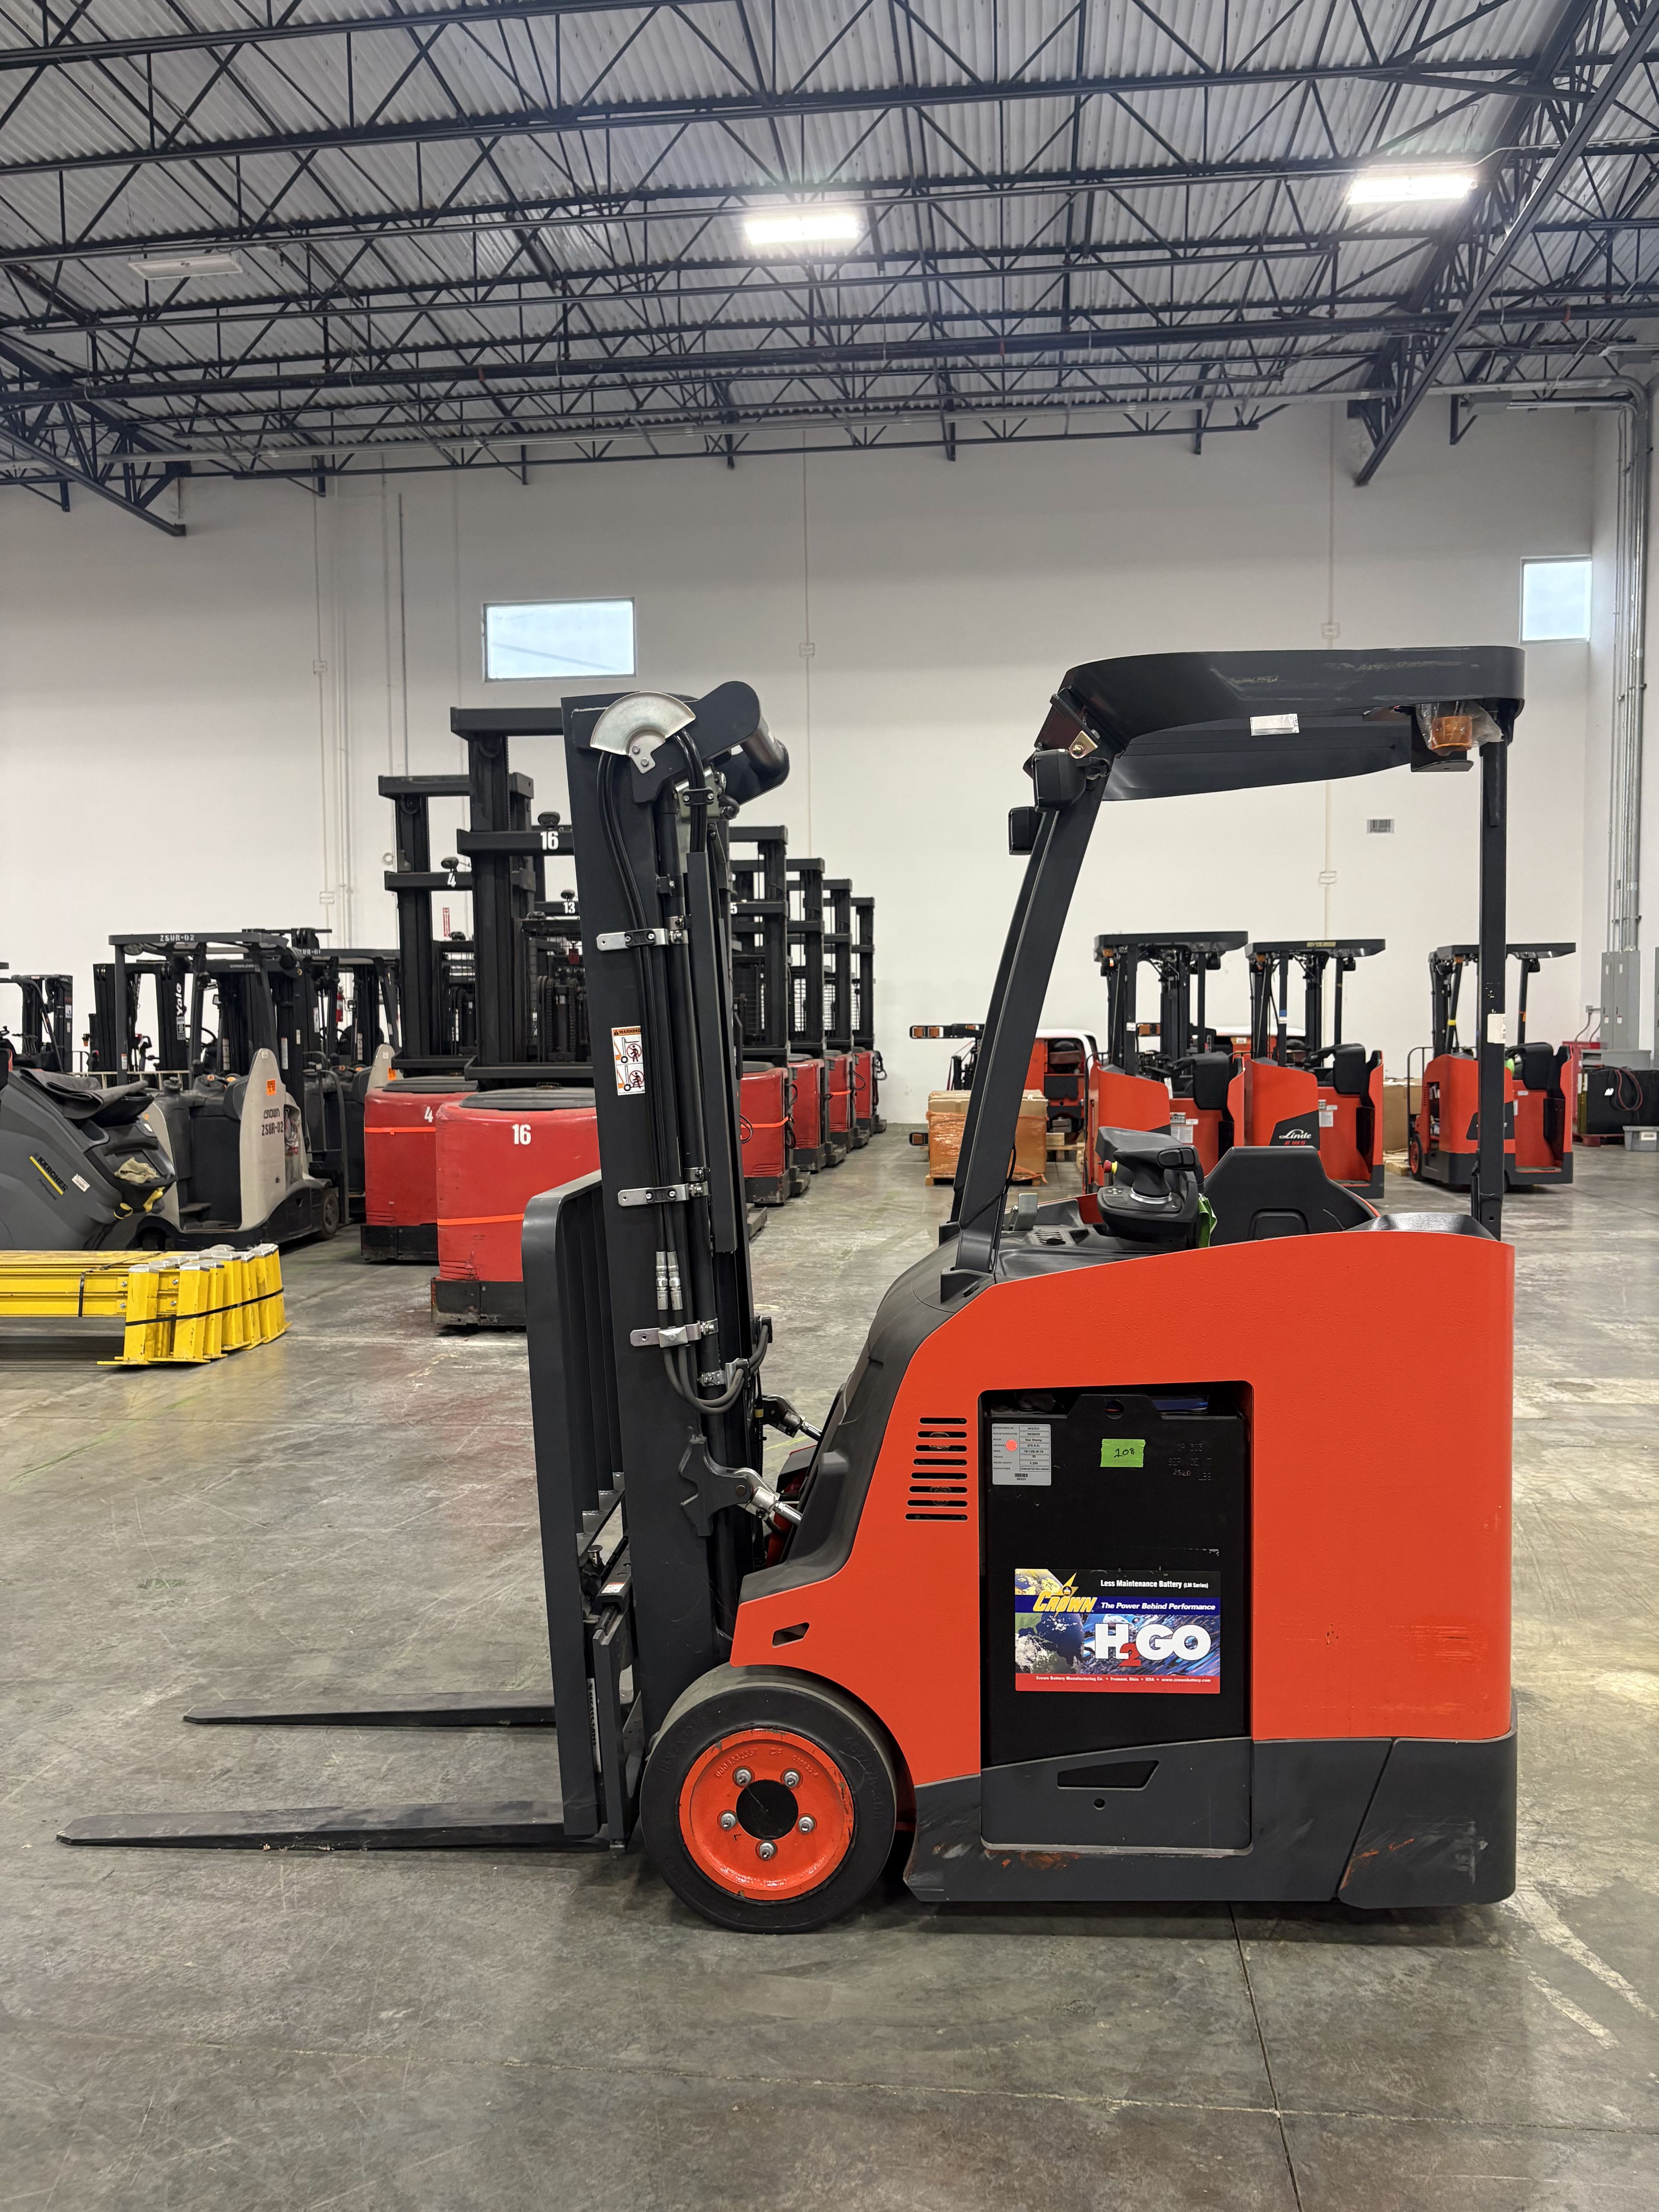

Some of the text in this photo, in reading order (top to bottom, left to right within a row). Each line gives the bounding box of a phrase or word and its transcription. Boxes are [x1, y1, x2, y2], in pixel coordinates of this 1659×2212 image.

[540, 831, 559, 850] 16
[448, 872, 456, 887] 4
[563, 902, 575, 914] 13
[424, 1106, 434, 1123] 4
[261, 1121, 283, 1136] ZSUR-02
[512, 1124, 531, 1145] 16
[1279, 1128, 1312, 1139] Linde
[1114, 1447, 1135, 1458] 108
[1159, 1580, 1182, 1589] Battery
[1033, 1590, 1098, 1612] CROWN
